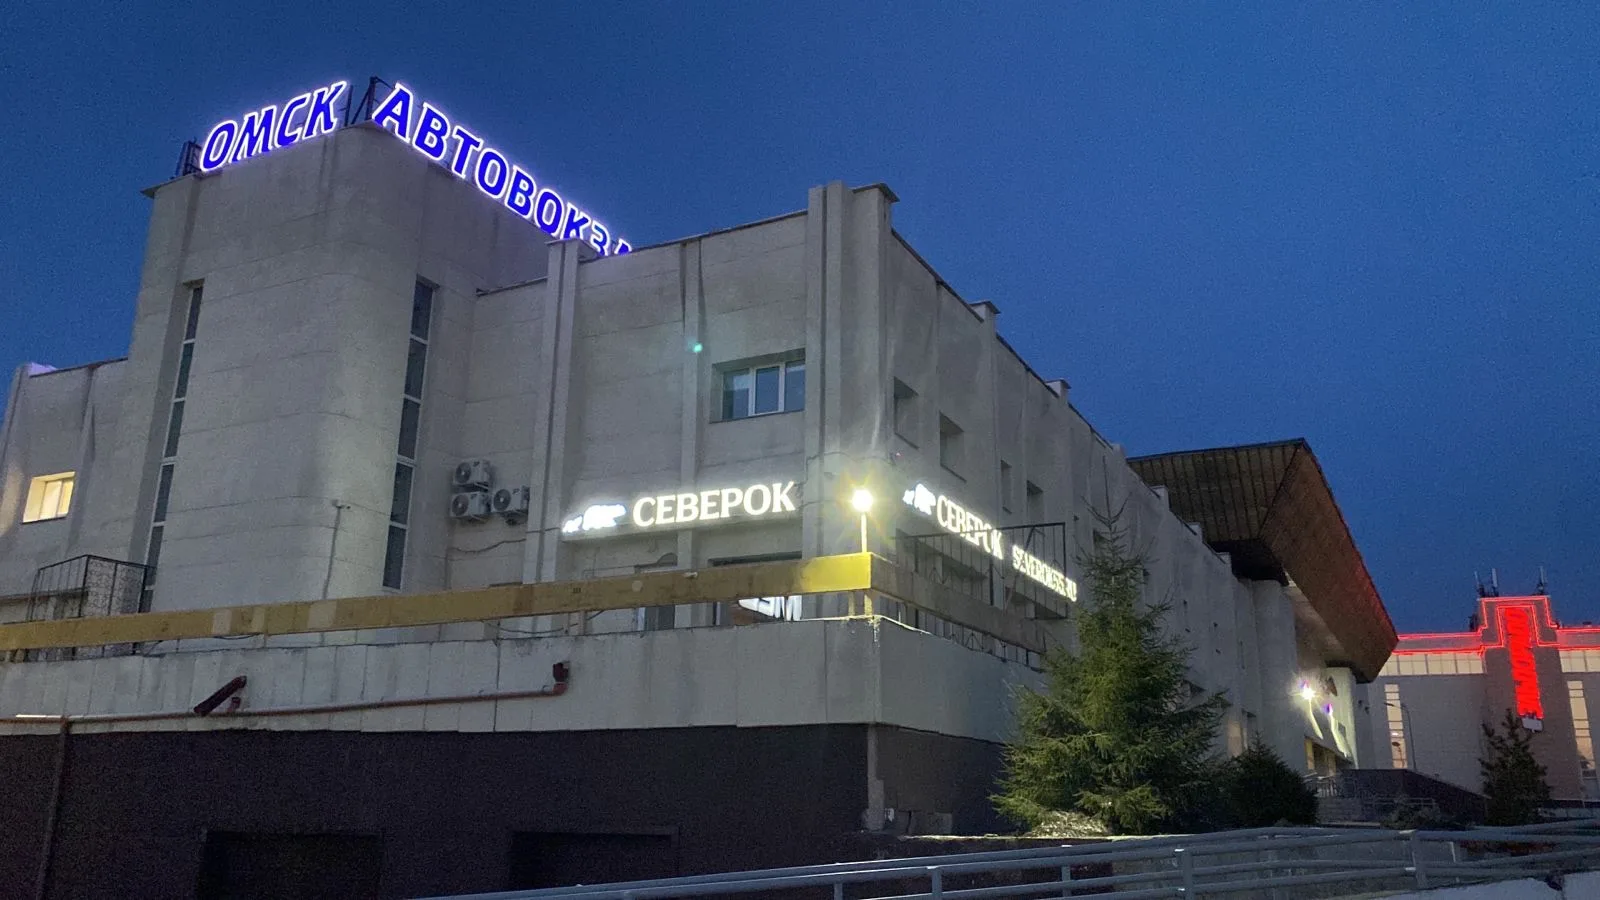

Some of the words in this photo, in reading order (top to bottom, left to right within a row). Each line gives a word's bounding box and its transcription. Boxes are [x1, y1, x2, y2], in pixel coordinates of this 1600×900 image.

[200, 81, 347, 172] ОМСК
[633, 480, 796, 527] СЕВЕРОК
[937, 495, 1003, 560] СЕВЕРОК
